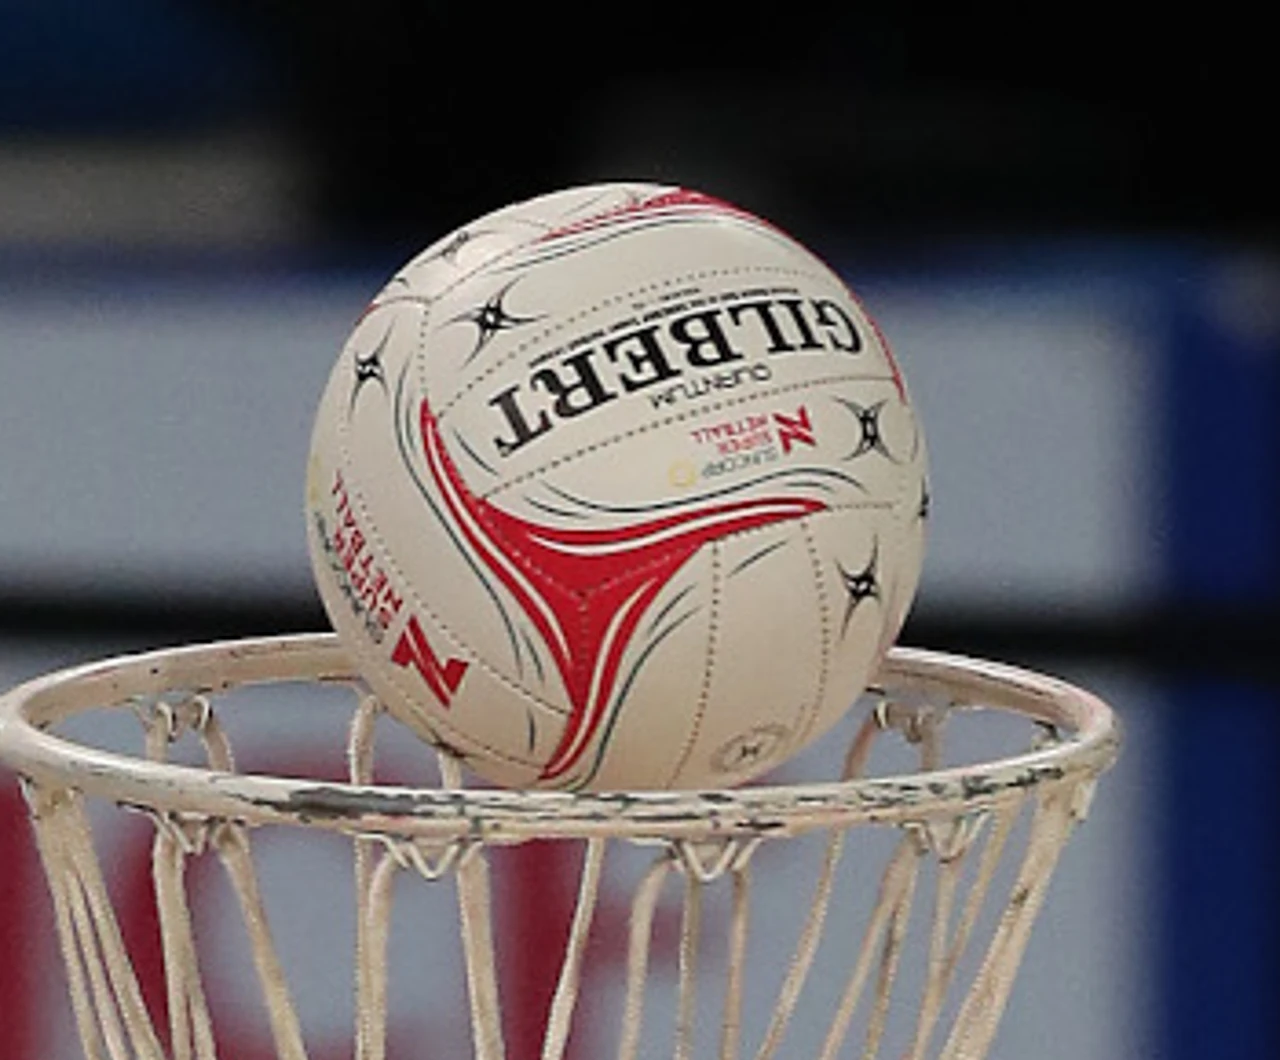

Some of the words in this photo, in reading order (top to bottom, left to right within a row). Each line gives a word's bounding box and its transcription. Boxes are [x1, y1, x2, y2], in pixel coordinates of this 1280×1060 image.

[488, 299, 862, 458] GILBERT
[649, 362, 773, 410] QUANTUM
[331, 469, 403, 613] NETBALL
[334, 527, 392, 630] SUPER
